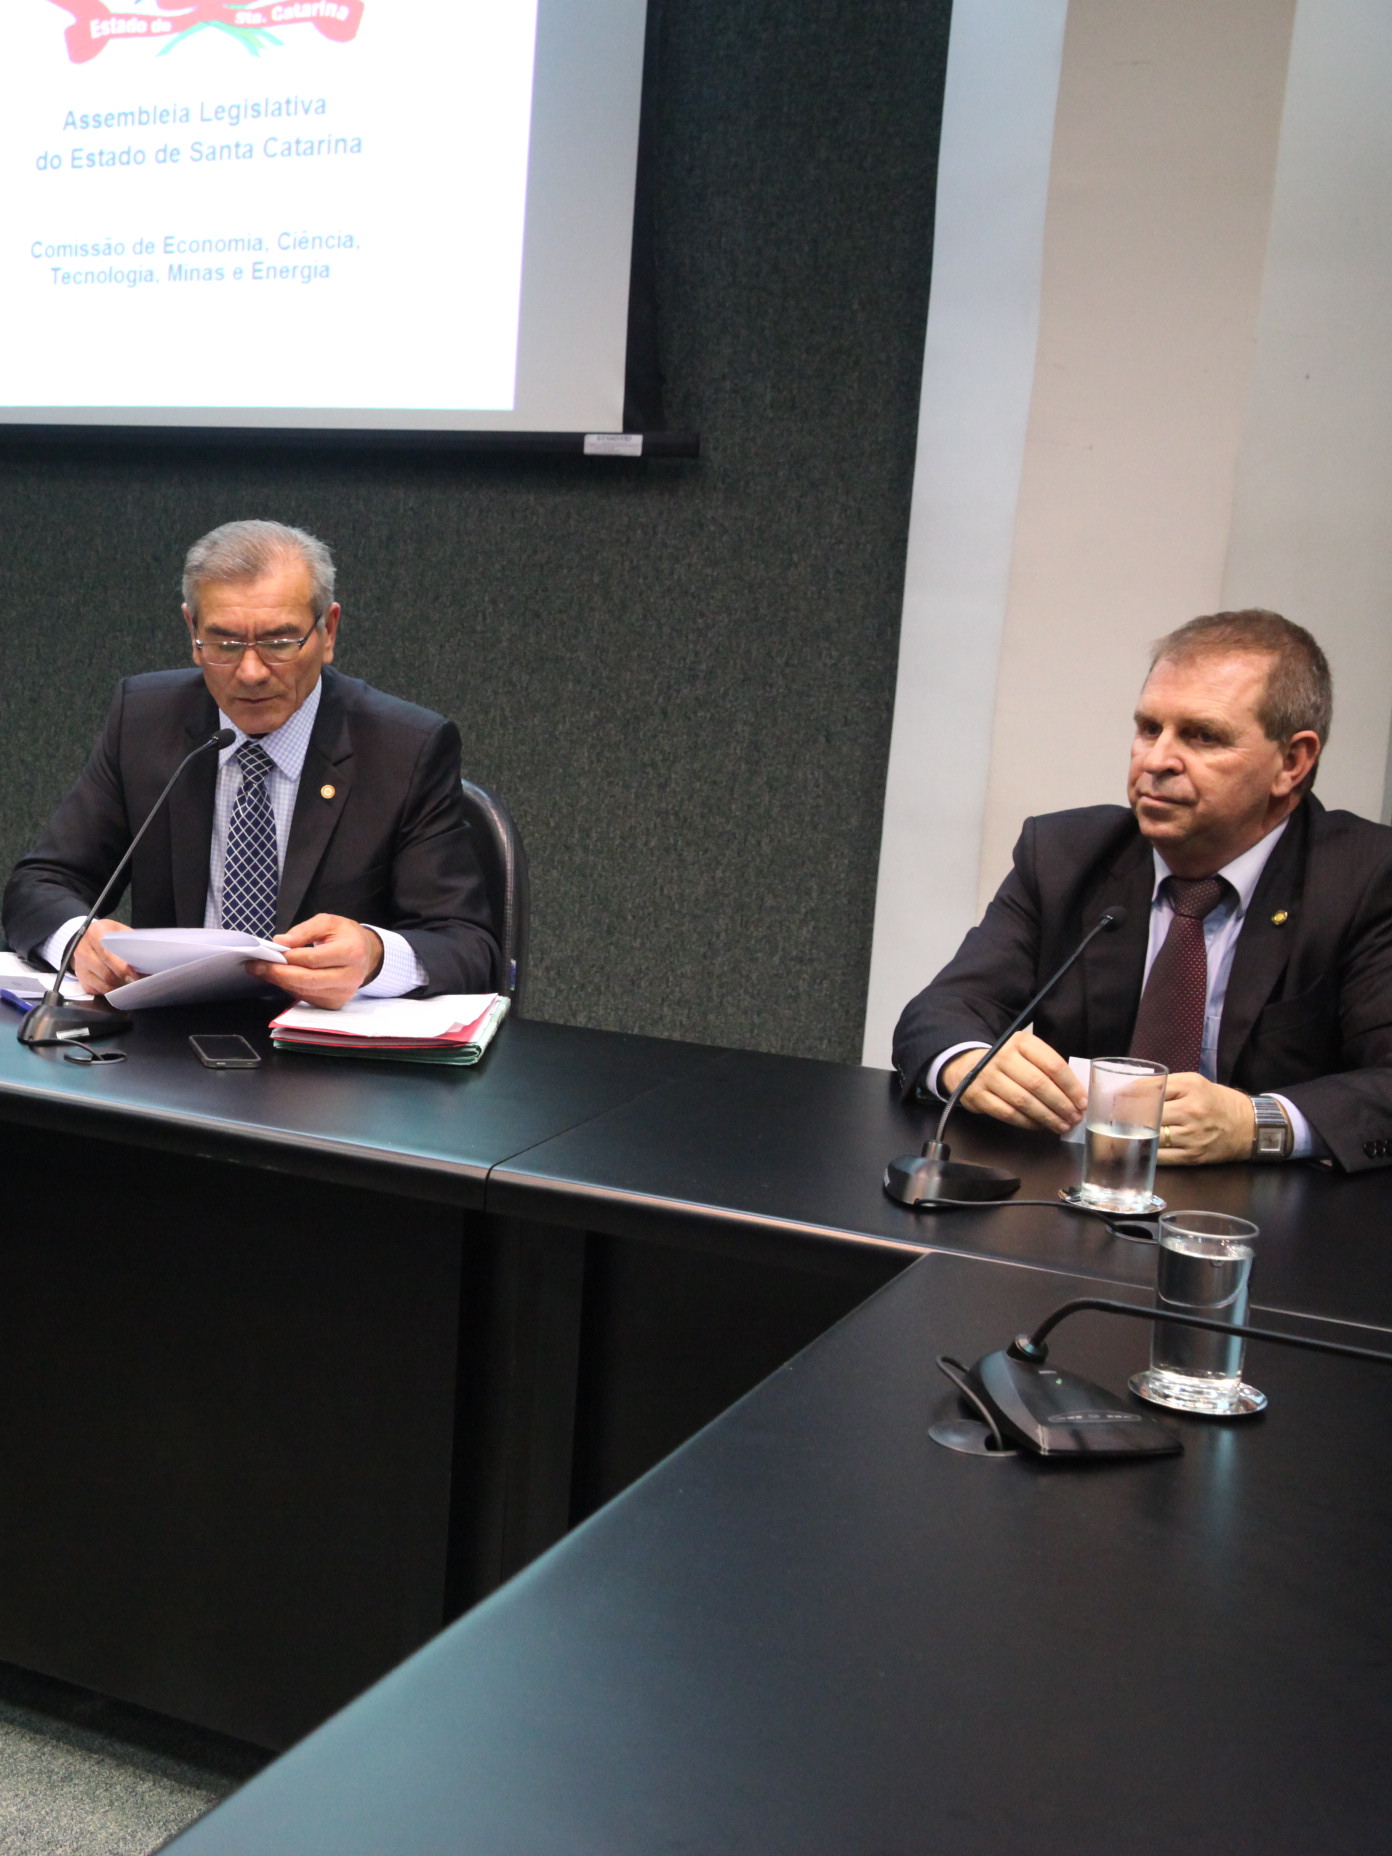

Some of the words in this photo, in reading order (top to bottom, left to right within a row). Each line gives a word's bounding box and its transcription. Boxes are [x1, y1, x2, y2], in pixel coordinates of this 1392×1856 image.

[234, 11, 266, 25] Sta.
[271, 0, 349, 22] Catarina
[90, 18, 147, 39] Estado
[63, 104, 190, 131] Assembleia
[200, 95, 327, 126] Legislativa
[36, 151, 62, 171] do
[71, 146, 146, 169] Estado
[155, 144, 181, 164] de
[190, 140, 254, 162] Santa
[263, 134, 364, 158] Catarina
[31, 237, 126, 259] Comissão
[133, 238, 155, 255] de
[168, 262, 225, 282] Minas
[233, 266, 243, 280] e
[252, 260, 331, 284] Energia
